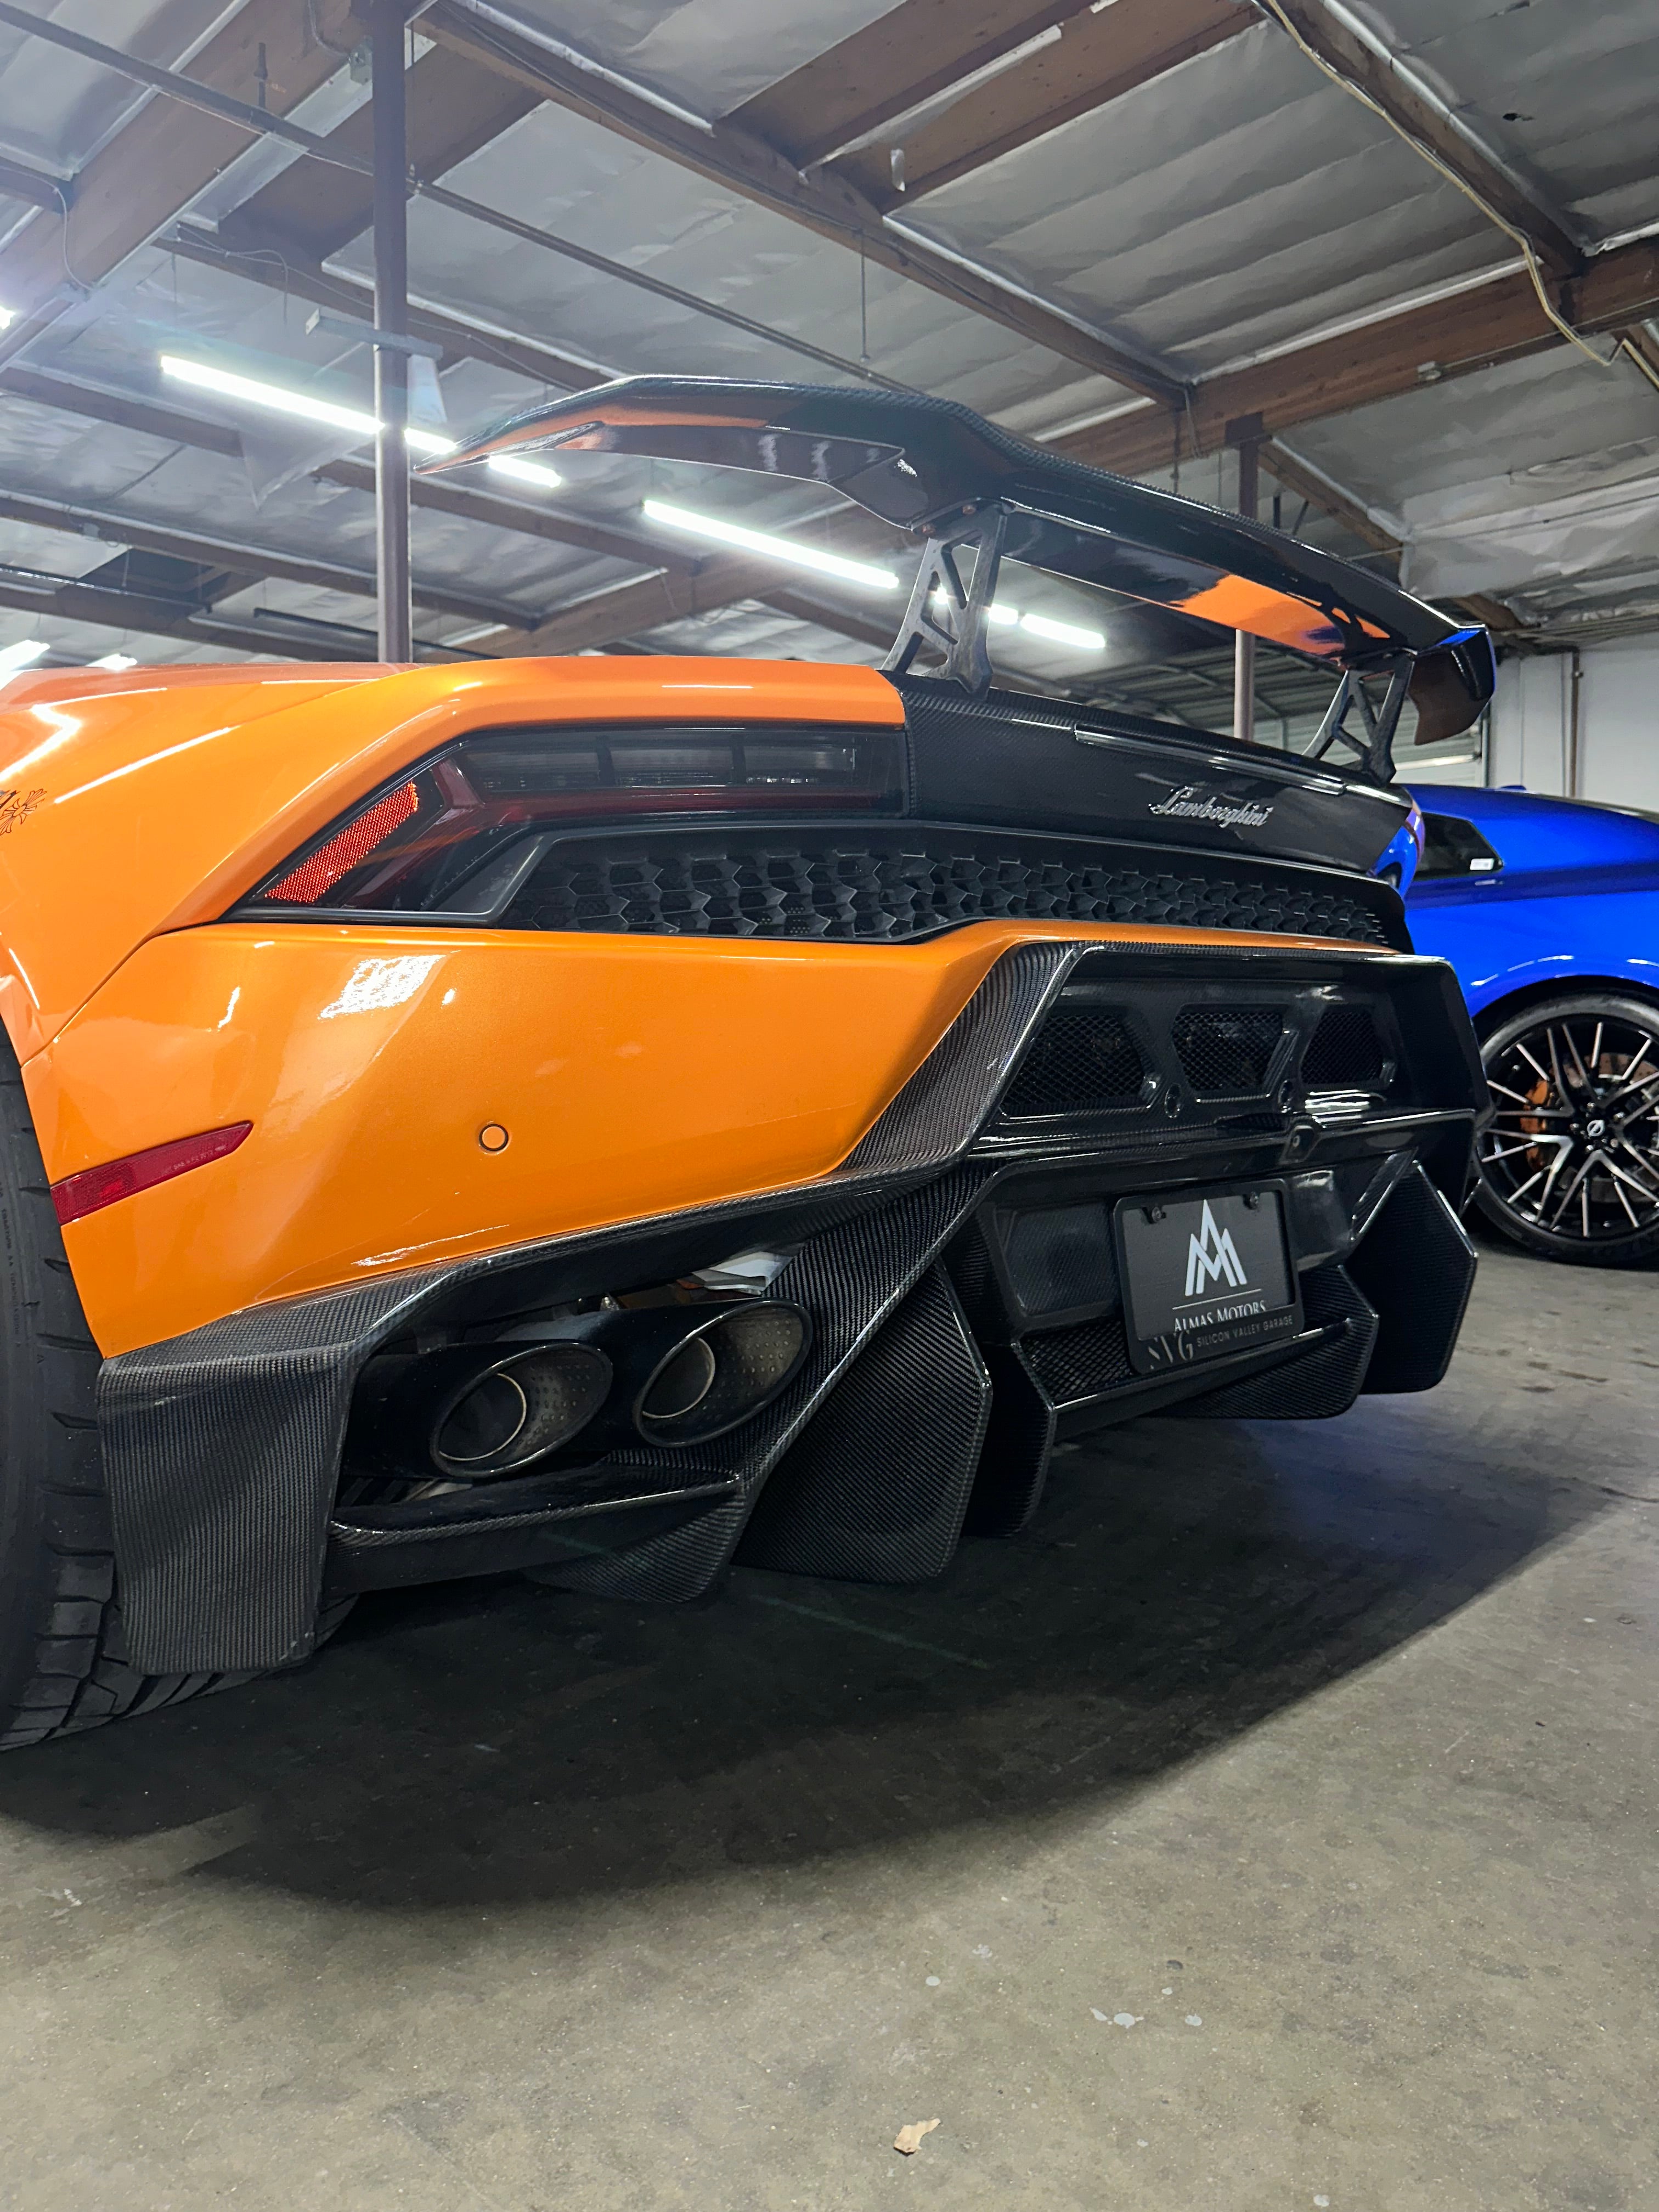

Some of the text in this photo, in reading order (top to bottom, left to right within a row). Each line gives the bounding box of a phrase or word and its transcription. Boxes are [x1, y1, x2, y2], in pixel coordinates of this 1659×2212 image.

[1148, 786, 1273, 828] Lamborghini
[1217, 1300, 1266, 1322] MOTORS
[1197, 1330, 1230, 1347] SILICON
[1232, 1323, 1261, 1338] VALLEY
[1262, 1314, 1293, 1331] GARAGE
